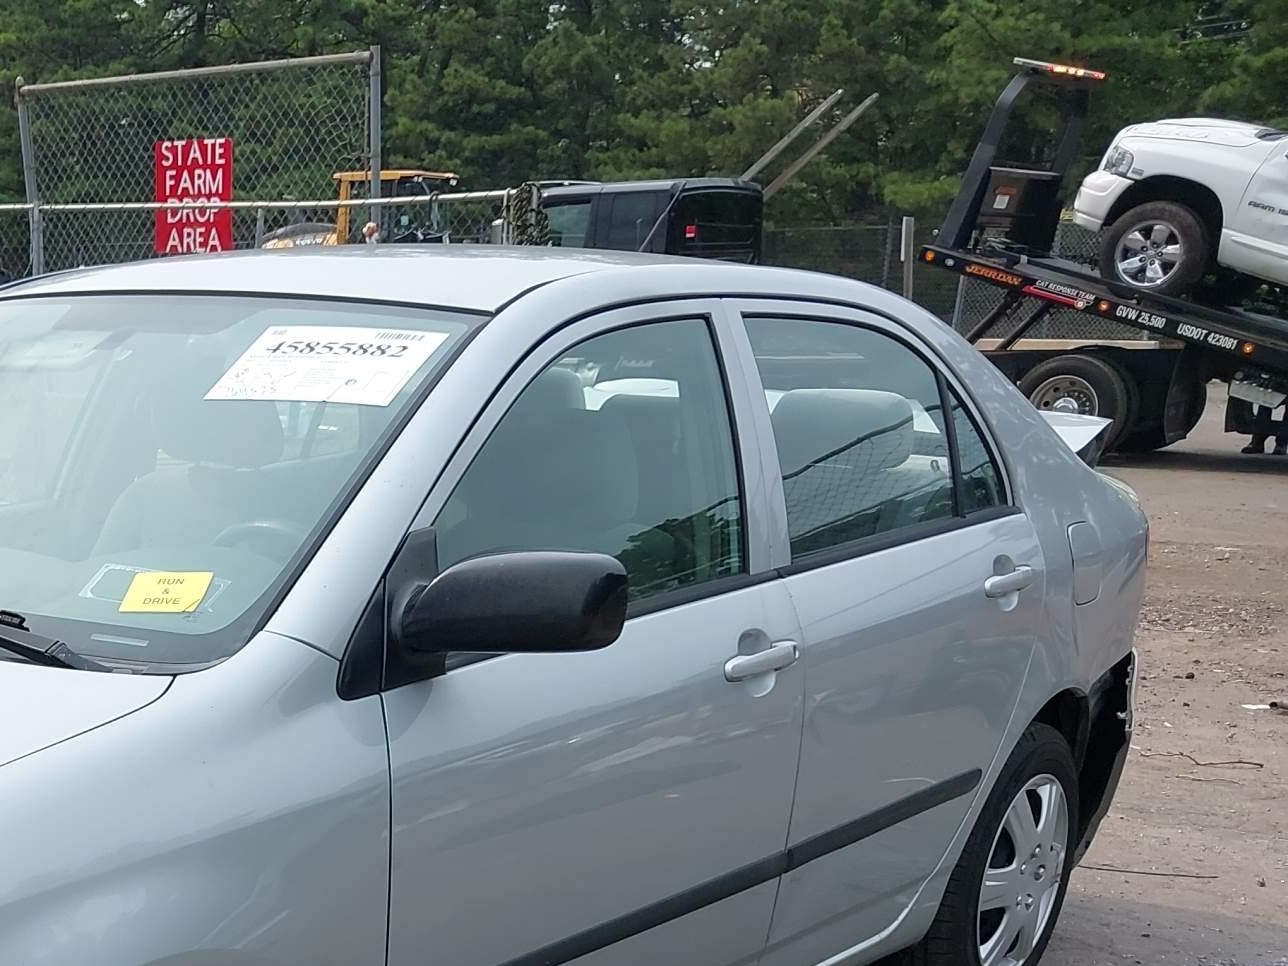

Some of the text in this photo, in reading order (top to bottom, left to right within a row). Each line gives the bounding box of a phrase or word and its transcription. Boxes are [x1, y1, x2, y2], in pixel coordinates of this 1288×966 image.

[161, 138, 226, 166] STATE
[165, 168, 223, 196] FARM
[167, 197, 221, 224] DROP
[166, 228, 222, 253] AREA
[1035, 280, 1096, 300] CAT RESPONSE TEAM
[1115, 305, 1239, 350] GVW 25,500 USDOT 423081
[265, 340, 409, 358] 45855882
[142, 597, 181, 605] DRIVE
